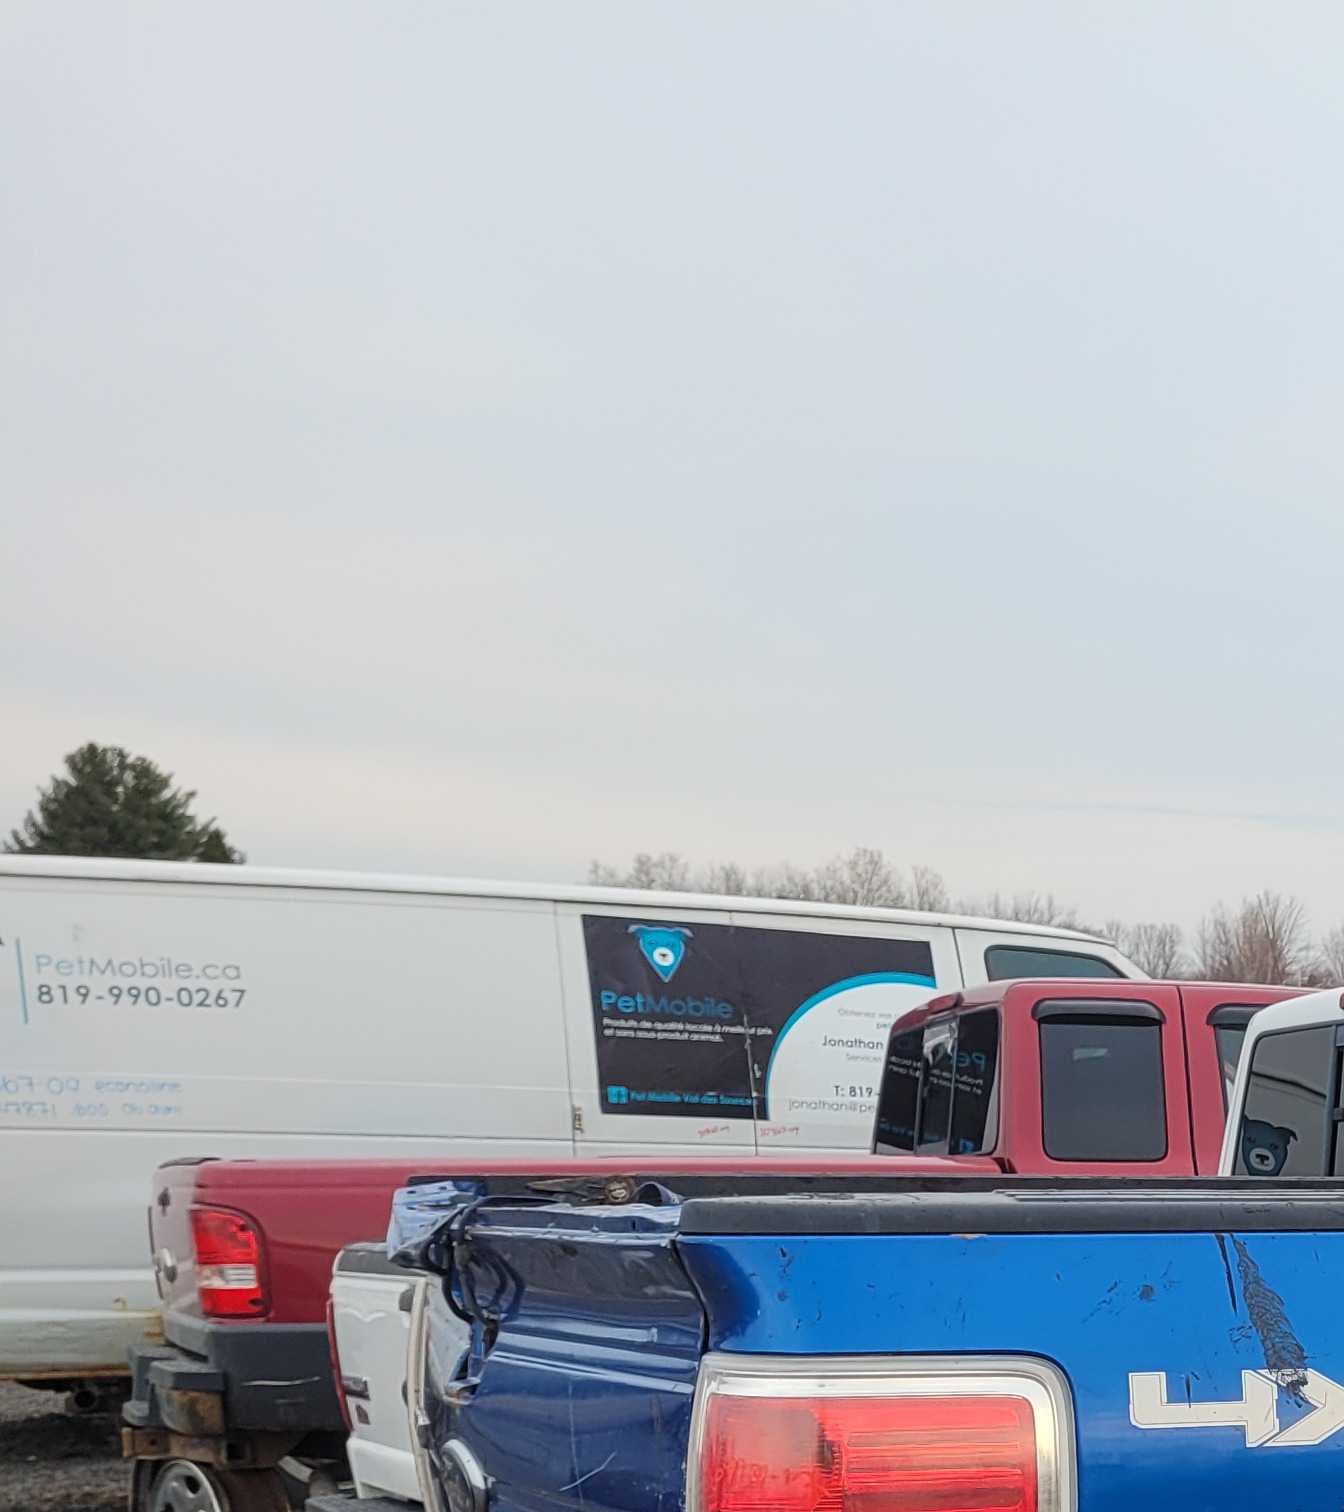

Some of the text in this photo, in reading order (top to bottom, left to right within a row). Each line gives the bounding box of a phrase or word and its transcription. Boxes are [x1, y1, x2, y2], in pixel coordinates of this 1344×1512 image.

[34, 953, 242, 981] PetMobile.ca
[36, 983, 247, 1008] 819-990-0267
[600, 988, 735, 1019] PetMobile
[822, 1035, 884, 1050] Jonathan
[833, 1085, 846, 1098] T:
